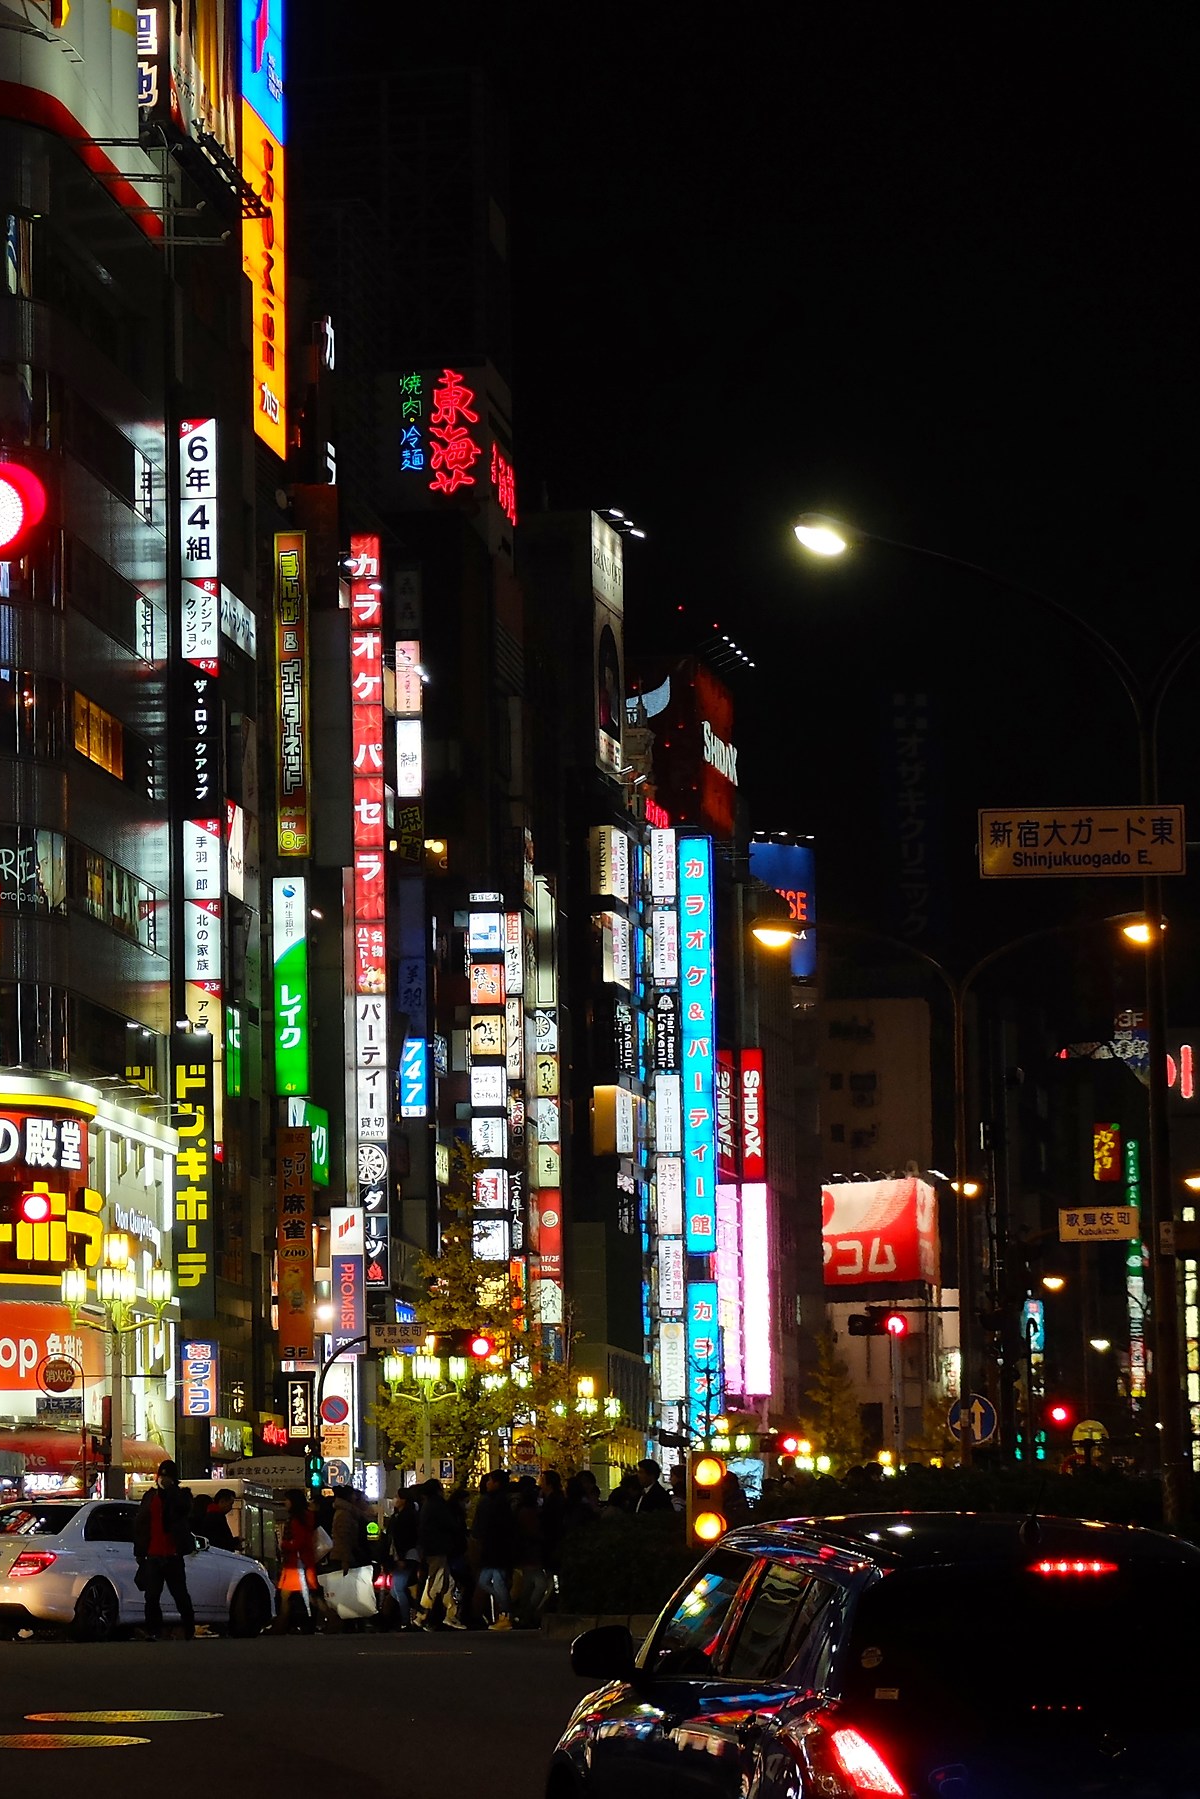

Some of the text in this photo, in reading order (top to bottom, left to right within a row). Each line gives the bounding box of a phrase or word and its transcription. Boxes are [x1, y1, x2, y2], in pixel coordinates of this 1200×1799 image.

[181, 422, 194, 433] 9F
[185, 436, 211, 562] 6年4組
[203, 581, 216, 591] 8F
[185, 598, 197, 654] クッション
[200, 596, 212, 646] アジア de
[280, 658, 303, 795] インターネット
[353, 554, 383, 882] カラオケパセラ
[193, 679, 208, 800] ザ・ロックアップ
[702, 719, 738, 786] SHIDAX
[206, 822, 218, 832] 5F
[280, 830, 307, 850] 8F
[400, 807, 422, 862] 麻雀
[896, 733, 930, 938] オザキクリニック
[990, 816, 1175, 849] 新宿大ガード東
[195, 836, 208, 891] 手羽一郎
[599, 868, 607, 891] OFF
[1012, 850, 1131, 869] Shinjukuogado
[206, 902, 219, 911] 4F
[285, 901, 294, 937] 新生銀行
[196, 914, 209, 971] 北の家族
[357, 927, 369, 968] ハニトー
[371, 931, 383, 957] 名物
[279, 984, 302, 1049] レイク
[360, 1003, 382, 1109] パーティー
[657, 1013, 666, 1069] L'avenir
[667, 1013, 675, 1068] Hair Resort
[685, 859, 711, 1234] カラオケ&パーティー館
[285, 1083, 297, 1092] 4F
[403, 1041, 423, 1104] 747
[361, 1117, 385, 1128] 貸切
[743, 1070, 761, 1158] SHIDAX
[176, 1064, 208, 1288] ドン・キホーテ
[281, 1156, 294, 1190] セット
[296, 1152, 307, 1187] フリー
[115, 1202, 155, 1242] Don Quijote
[281, 1194, 306, 1240] 麻雀
[363, 1190, 384, 1258] ダーツ
[1066, 1212, 1131, 1227] 歌舞伎町
[1077, 1227, 1120, 1236] Kabukicho
[283, 1247, 307, 1258] ZOO
[541, 1255, 560, 1263] 1F/2F
[341, 1264, 355, 1330] PROMISE
[374, 1326, 422, 1337] 歌舞伎町
[284, 1347, 308, 1358] 3F
[45, 1369, 73, 1383] 消火栓
[188, 1360, 211, 1415] ダイコク
[327, 1466, 338, 1484] P
